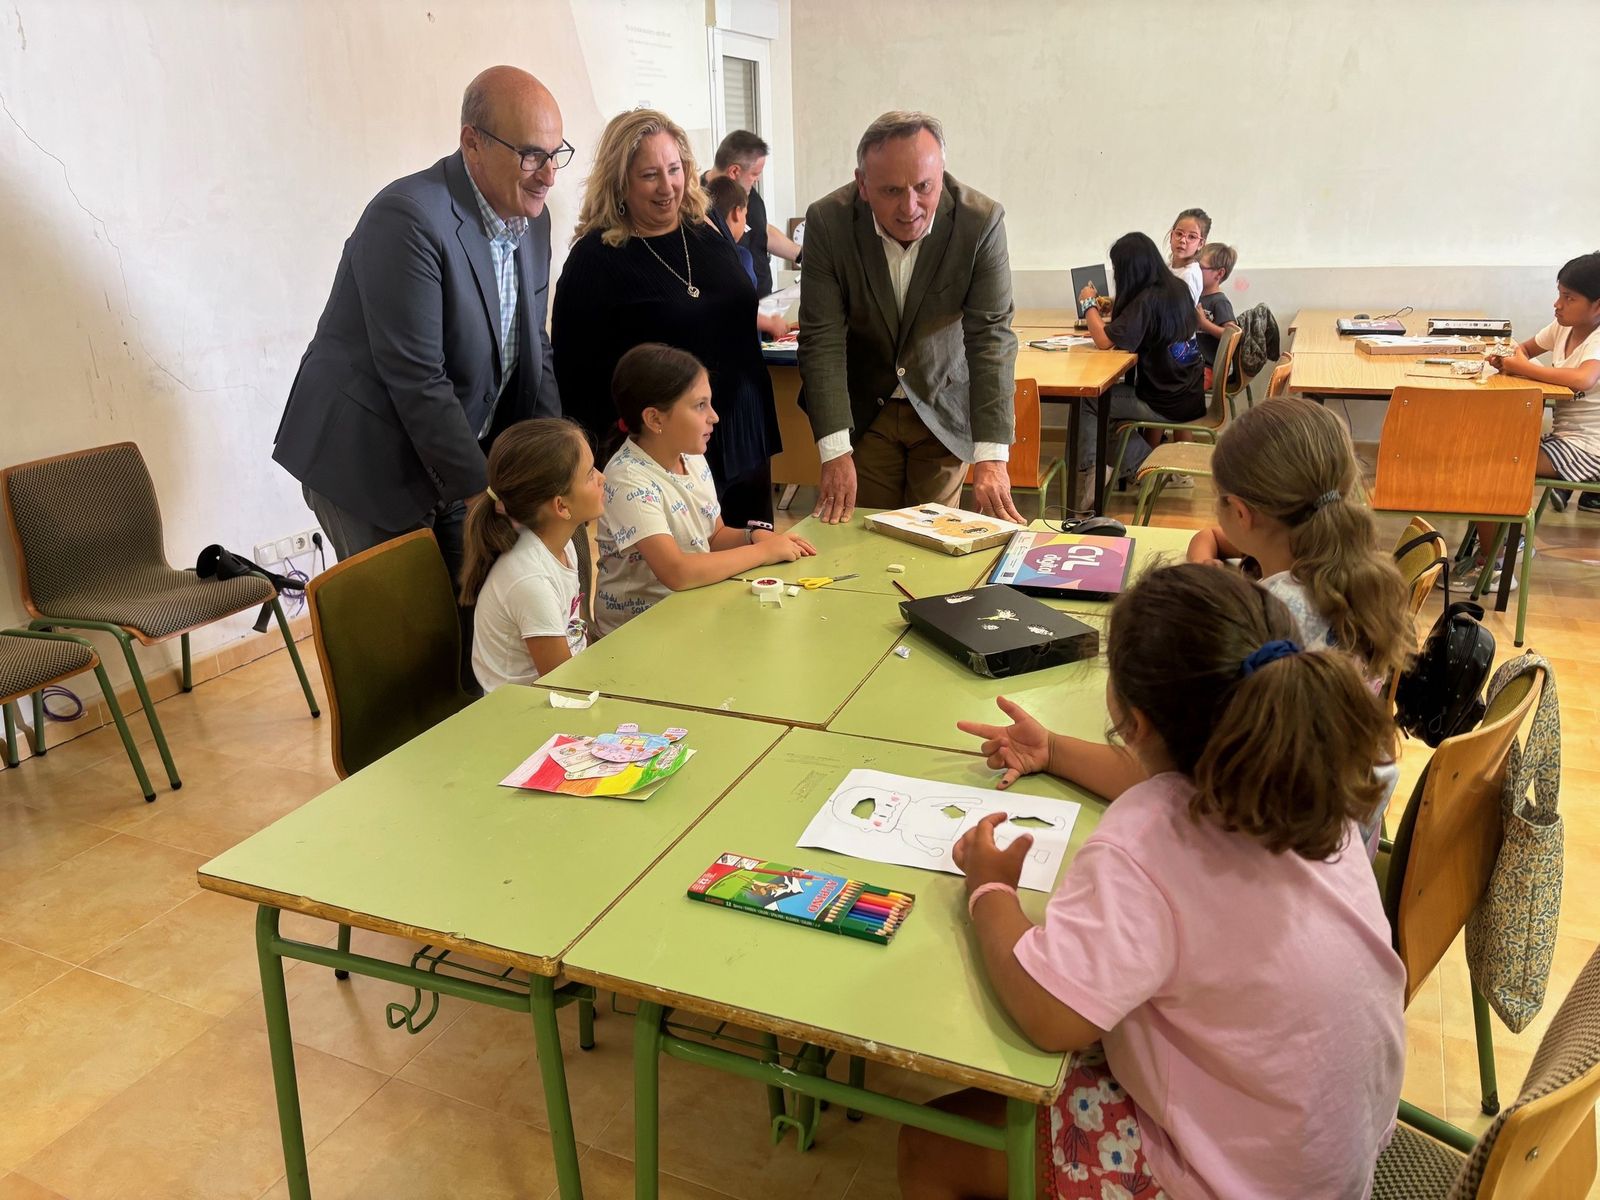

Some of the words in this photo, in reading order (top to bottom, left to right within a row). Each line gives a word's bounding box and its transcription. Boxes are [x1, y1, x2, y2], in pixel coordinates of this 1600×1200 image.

[626, 487, 644, 502] Club
[1035, 553, 1062, 575] digital
[808, 879, 839, 913] ALPINO
